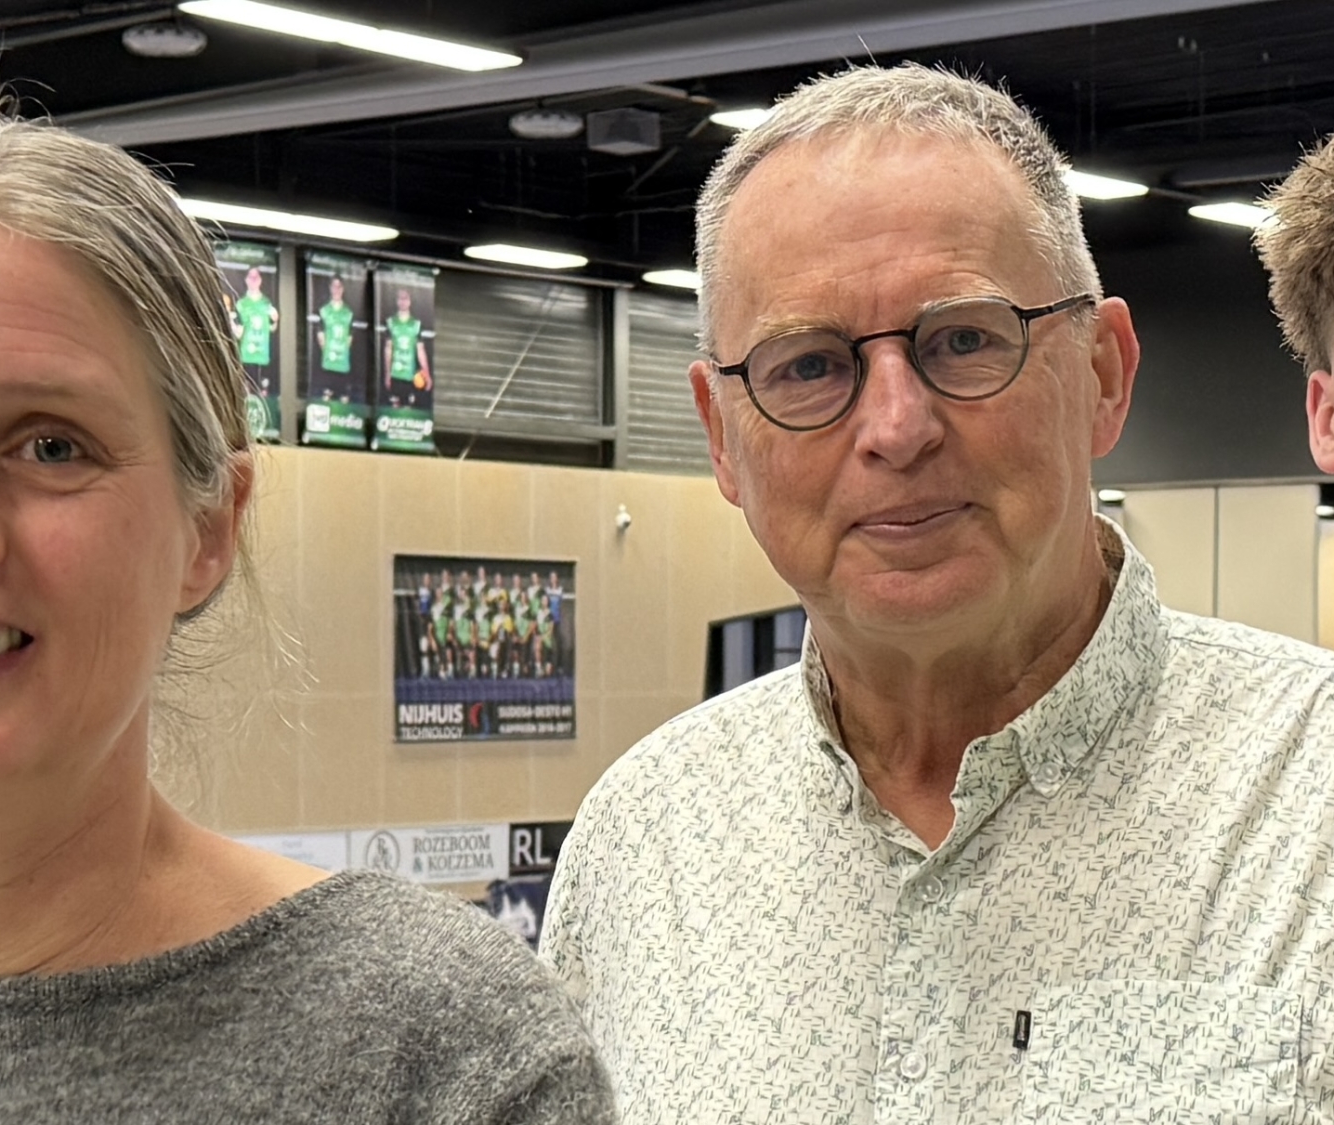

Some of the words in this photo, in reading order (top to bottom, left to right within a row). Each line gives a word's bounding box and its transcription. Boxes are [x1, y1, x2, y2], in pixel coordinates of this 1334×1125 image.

[399, 703, 464, 724] NIJHUIS
[401, 727, 464, 740] TECHNOLOGY
[413, 834, 490, 852] ROZEBOOM
